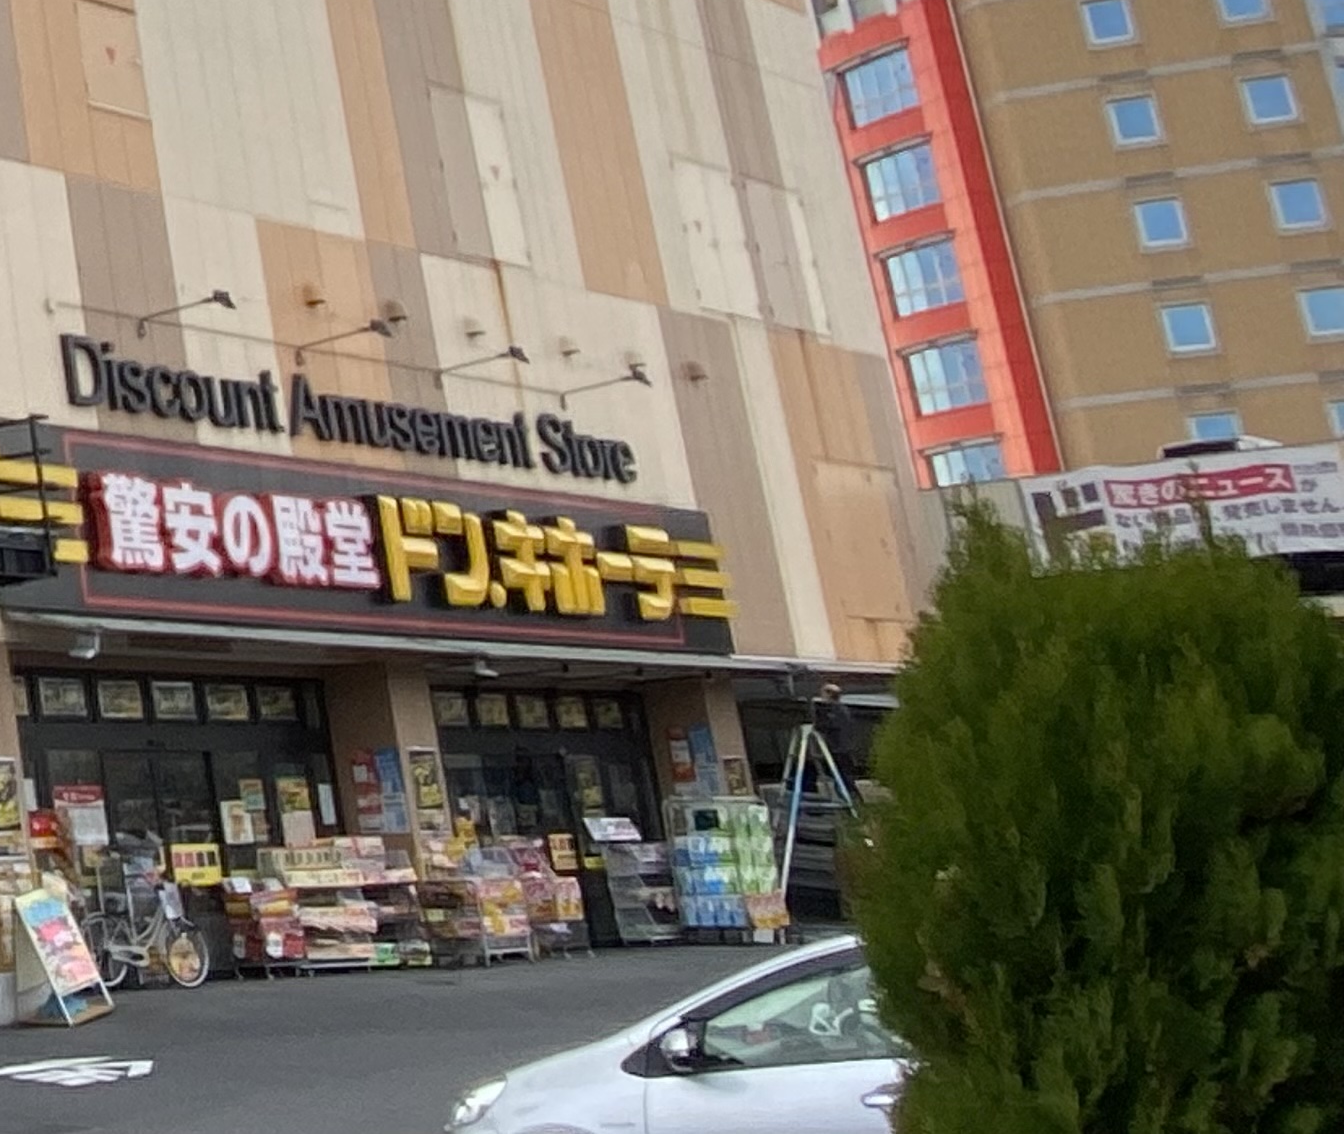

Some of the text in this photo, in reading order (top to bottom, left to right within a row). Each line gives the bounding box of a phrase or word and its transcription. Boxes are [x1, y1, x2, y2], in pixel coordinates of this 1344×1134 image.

[59, 332, 639, 484] Discount Amusement Store
[102, 473, 382, 590] 驚安の殿堂
